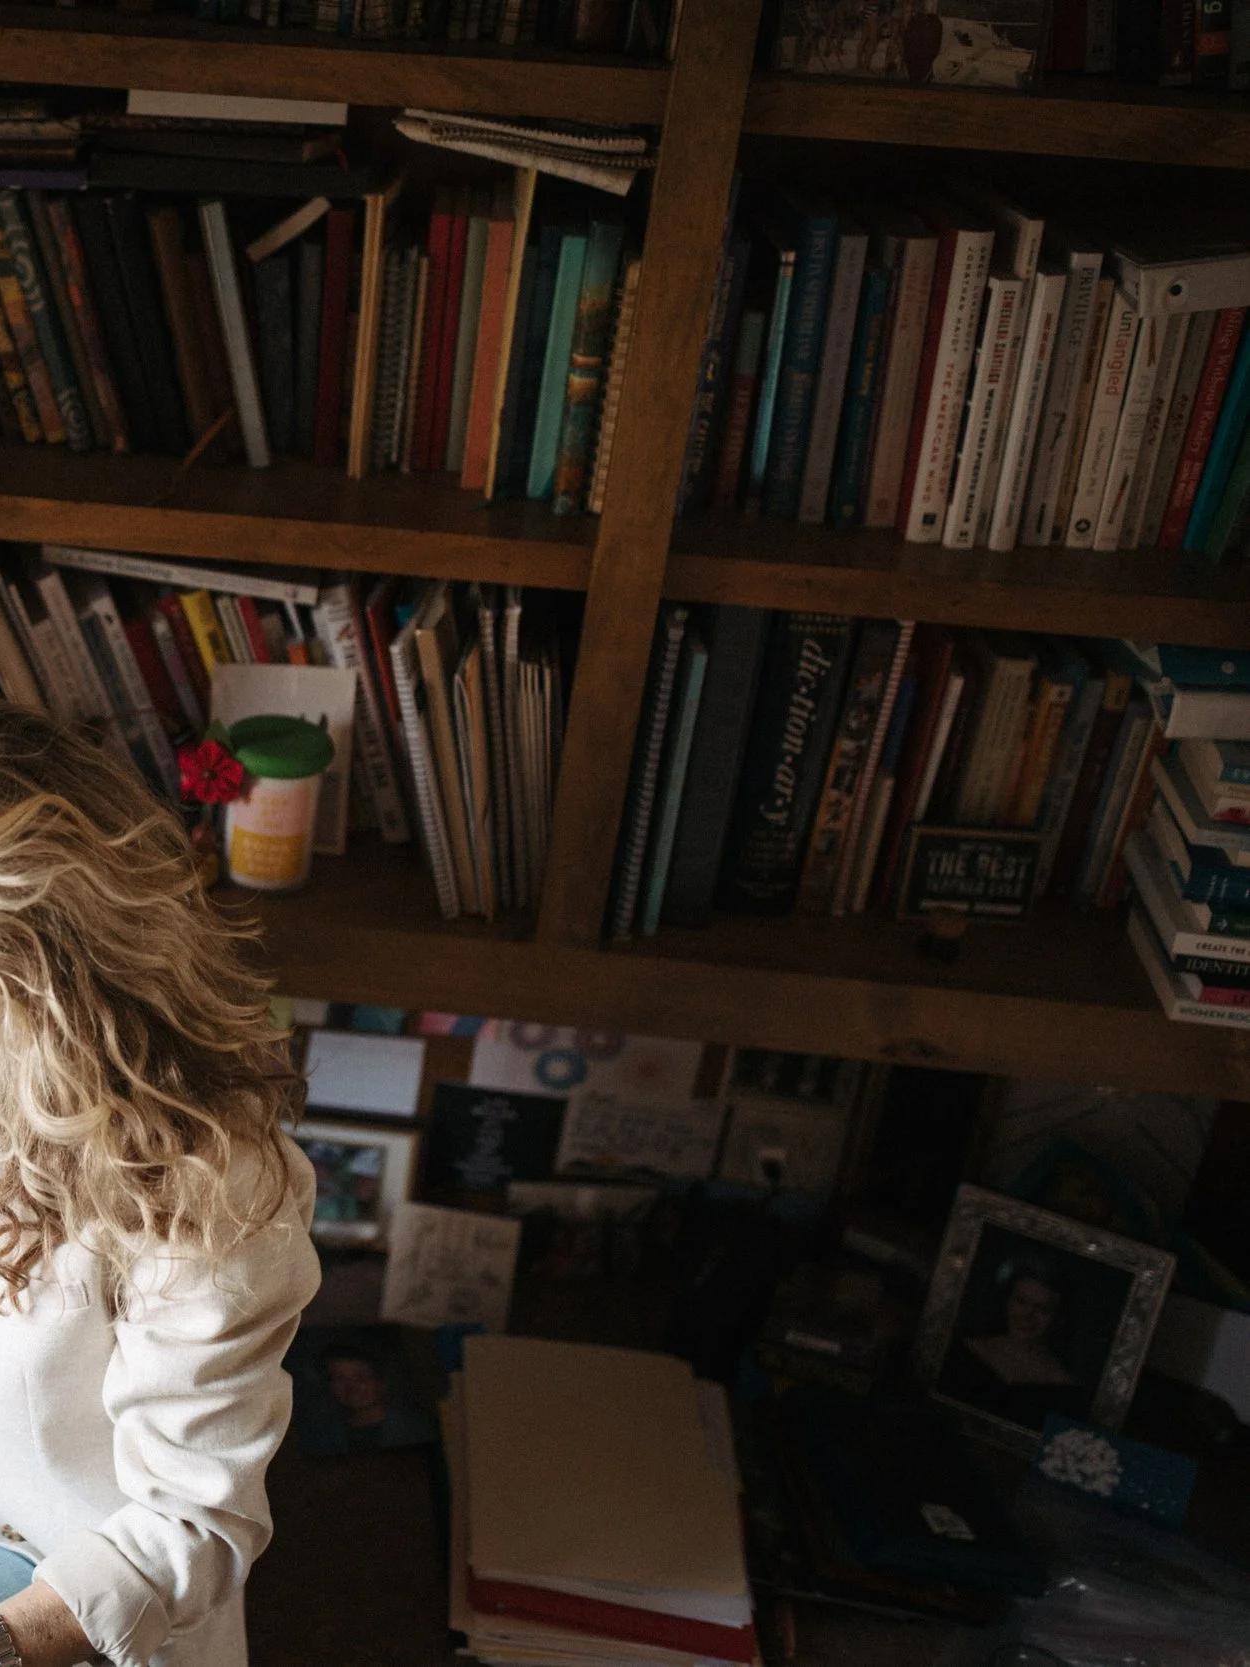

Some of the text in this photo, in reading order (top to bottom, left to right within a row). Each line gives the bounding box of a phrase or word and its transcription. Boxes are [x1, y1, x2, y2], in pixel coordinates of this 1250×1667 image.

[951, 247, 973, 354] JONATHAN HAIDT
[1069, 267, 1095, 347] PRIVILEGE
[1220, 308, 1243, 350] blings
[955, 372, 964, 398] THE
[1104, 310, 1135, 397] untangled
[923, 362, 954, 504] THE AMERICAN MIND
[982, 388, 994, 419] WHEN
